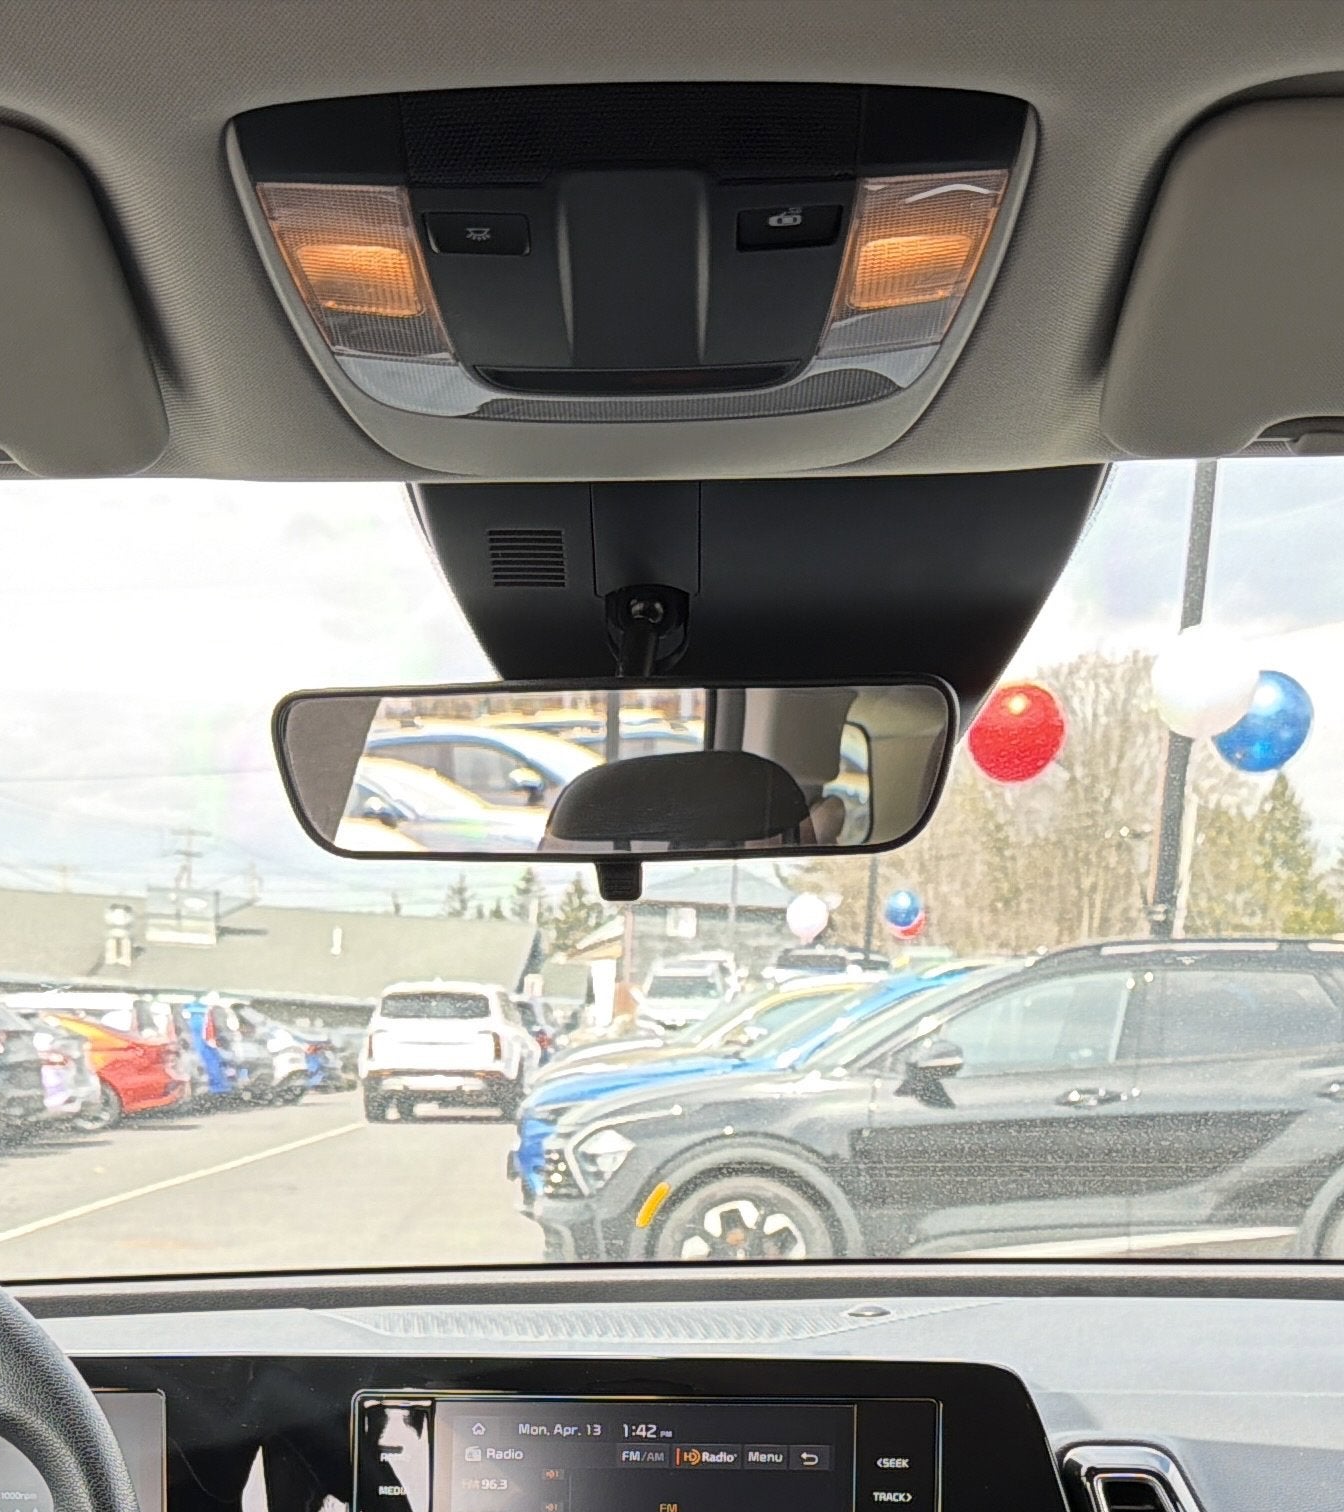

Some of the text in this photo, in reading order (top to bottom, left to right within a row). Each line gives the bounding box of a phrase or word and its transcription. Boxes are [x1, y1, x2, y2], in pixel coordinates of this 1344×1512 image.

[554, 1424, 582, 1438] Apr.
[586, 1424, 602, 1436] 13
[622, 1423, 657, 1438] 1:42
[486, 1448, 524, 1460] Radio
[621, 1450, 665, 1463] FM/AM
[748, 1451, 783, 1463] Menu
[481, 1478, 508, 1490] 96.3
